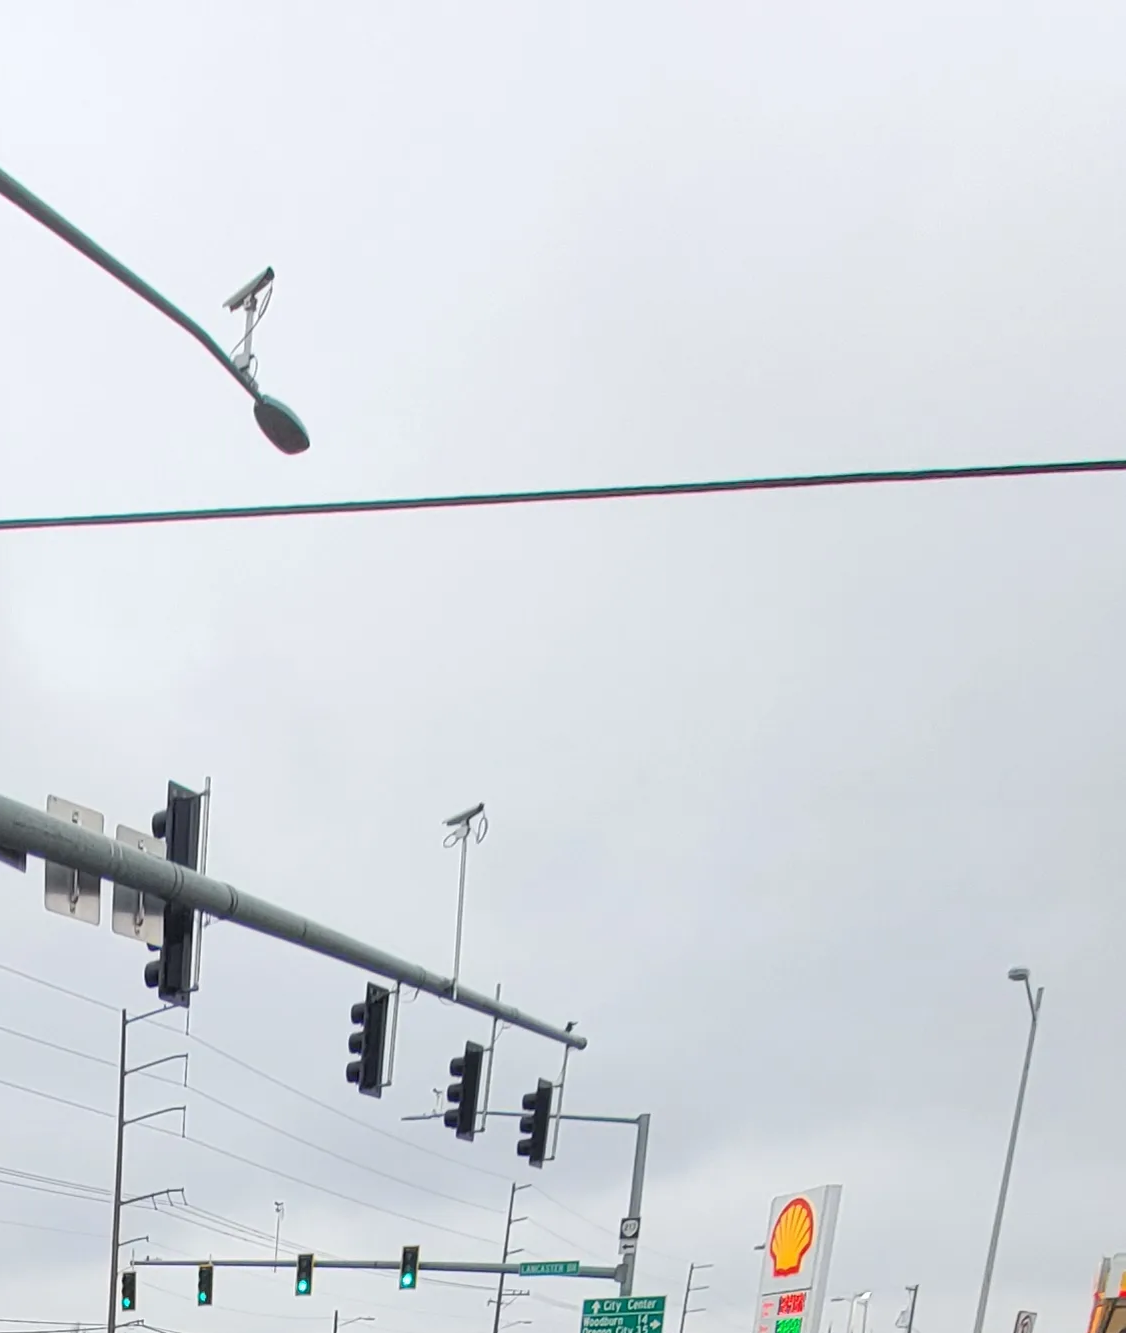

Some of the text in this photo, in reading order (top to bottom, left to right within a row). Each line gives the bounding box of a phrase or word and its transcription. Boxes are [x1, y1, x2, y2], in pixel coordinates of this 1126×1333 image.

[521, 1263, 564, 1274] LANCASTER
[603, 1299, 657, 1313] City Center
[583, 1314, 648, 1327] Woodburn 14
